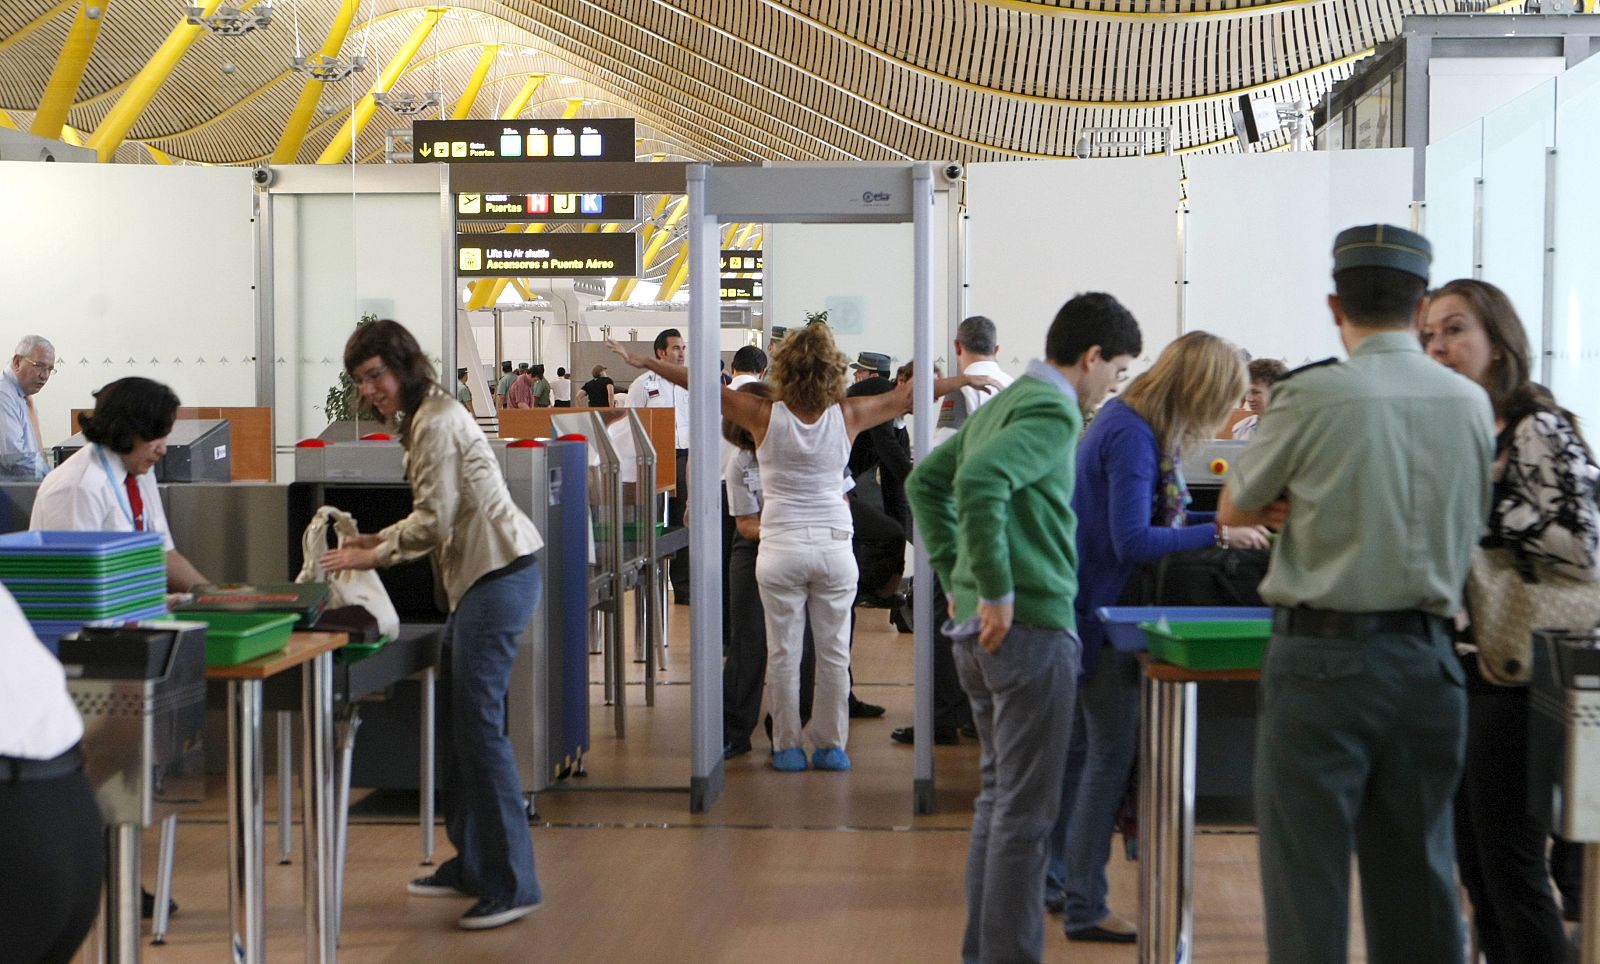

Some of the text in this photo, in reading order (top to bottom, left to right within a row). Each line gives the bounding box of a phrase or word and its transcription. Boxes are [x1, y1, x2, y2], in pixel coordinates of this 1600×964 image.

[486, 203, 522, 213] Puertas
[531, 194, 545, 211] H
[584, 194, 598, 211] K
[486, 248, 550, 258] Lifts to Air shuttle
[486, 259, 540, 270] Ascensores
[551, 259, 583, 270] Puente
[586, 258, 614, 270] Aéreo
